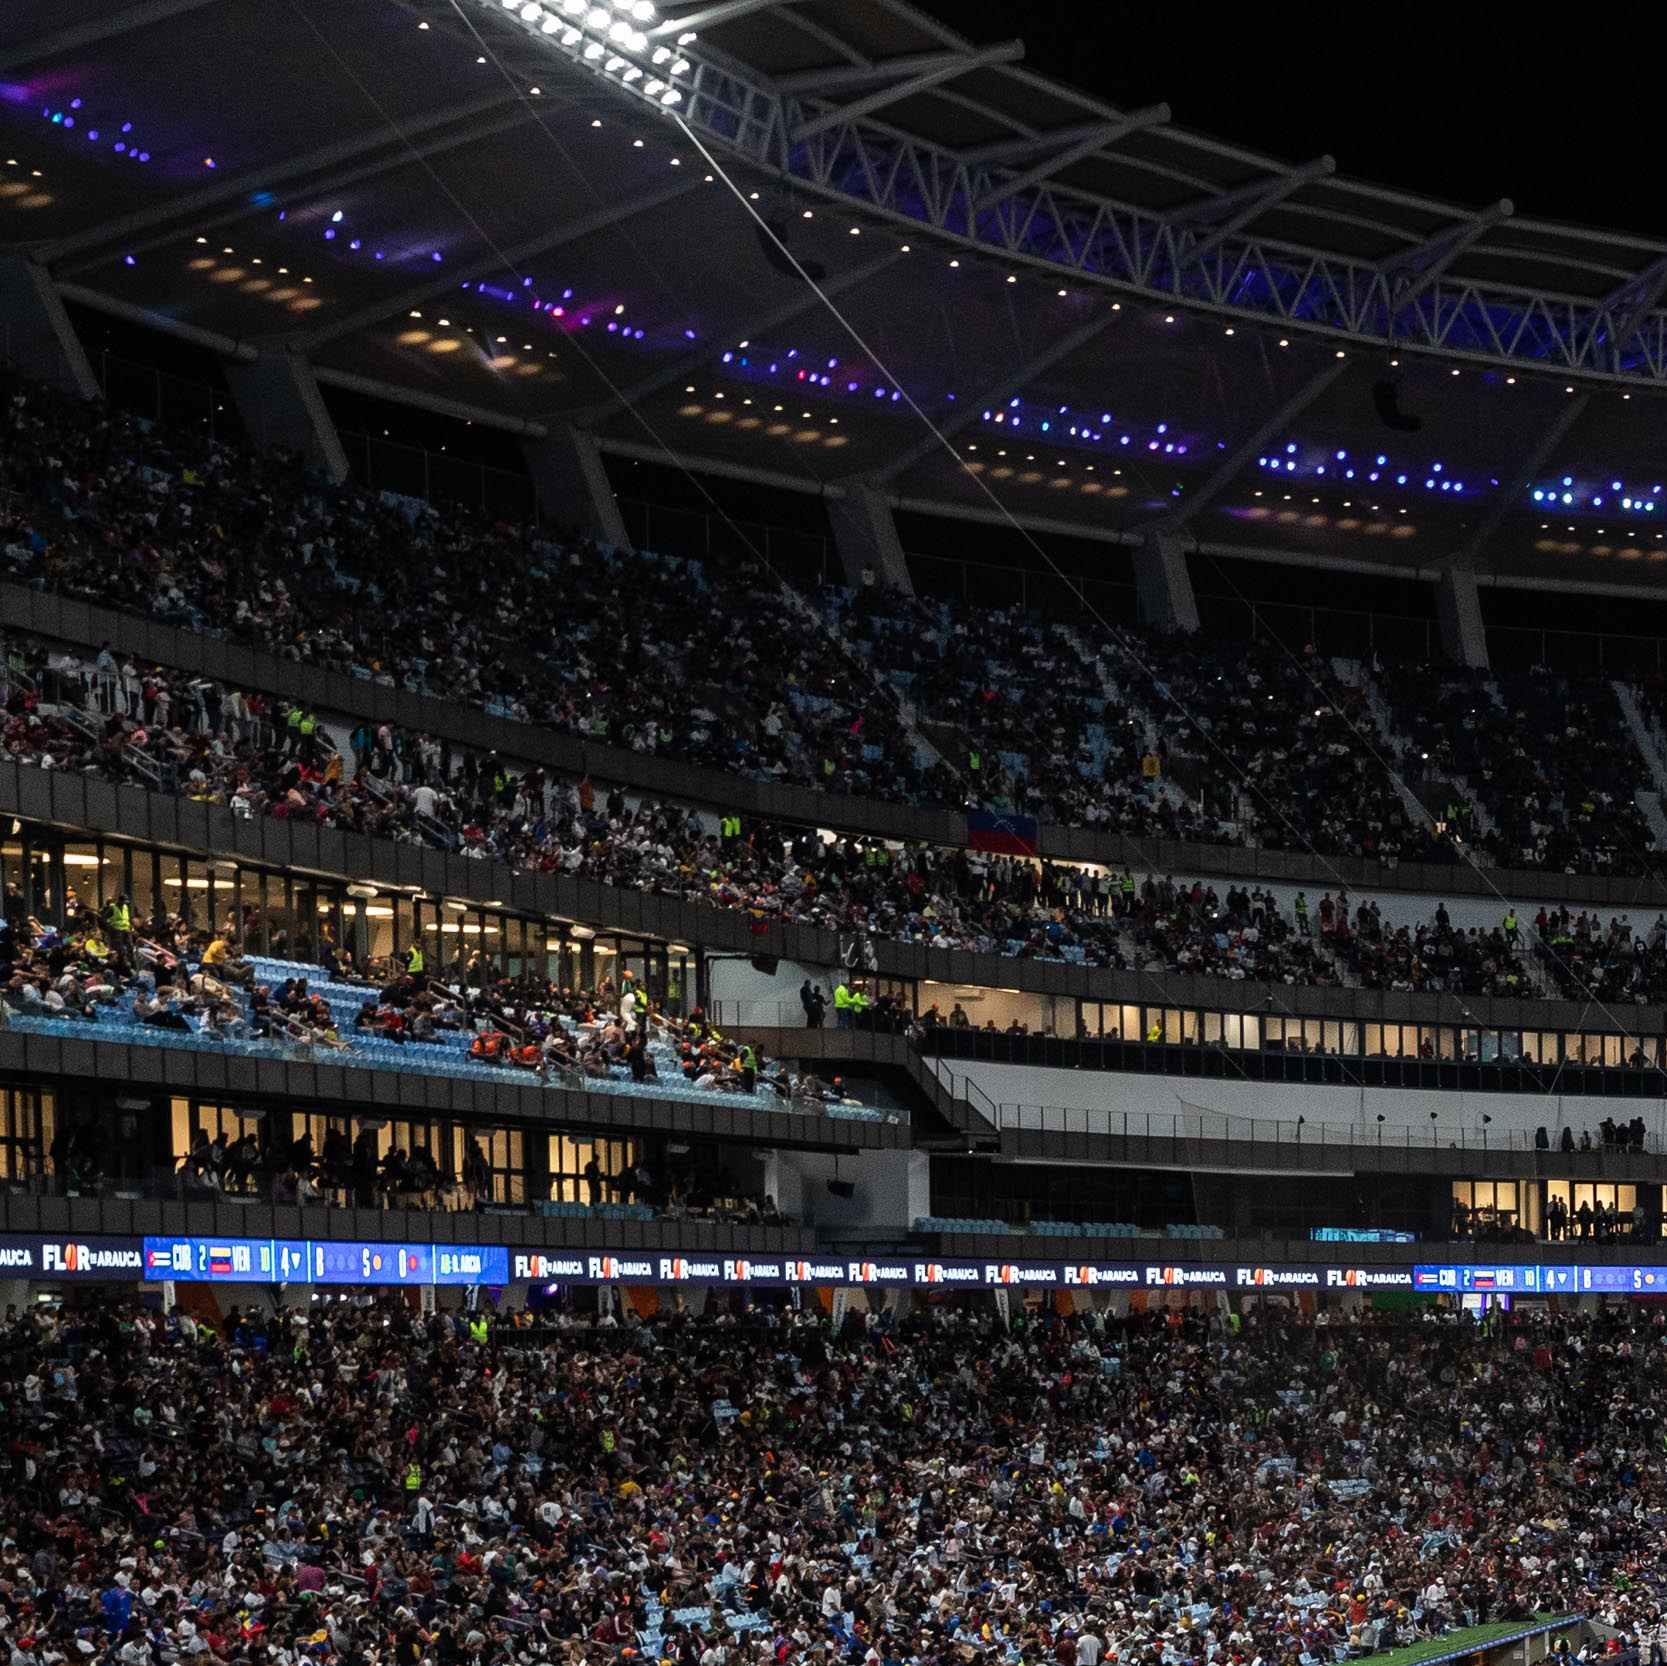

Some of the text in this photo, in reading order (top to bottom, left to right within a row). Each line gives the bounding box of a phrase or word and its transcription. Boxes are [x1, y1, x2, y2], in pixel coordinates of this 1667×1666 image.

[42, 1244, 141, 1270] FLOR ARAUCA
[199, 1244, 206, 1271] 2
[281, 1247, 289, 1277] 4
[362, 1247, 371, 1277] S
[515, 1255, 583, 1277] FLOR ARAUCA
[985, 1265, 1056, 1283] FLOR ARAUCA
[1064, 1266, 1138, 1283] FLOR ARAUCA
[1146, 1267, 1225, 1284] FLOR ARAUCA
[1237, 1268, 1318, 1285] FLOR ARAUCA
[1326, 1269, 1411, 1286] FLOR ARAUCA
[1439, 1269, 1456, 1286] CUB
[1463, 1269, 1470, 1286] 2
[1495, 1269, 1514, 1286] VEN
[1524, 1269, 1535, 1286] 10
[1546, 1269, 1555, 1289] 4
[1583, 1269, 1592, 1289] B
[1633, 1269, 1642, 1289] S
